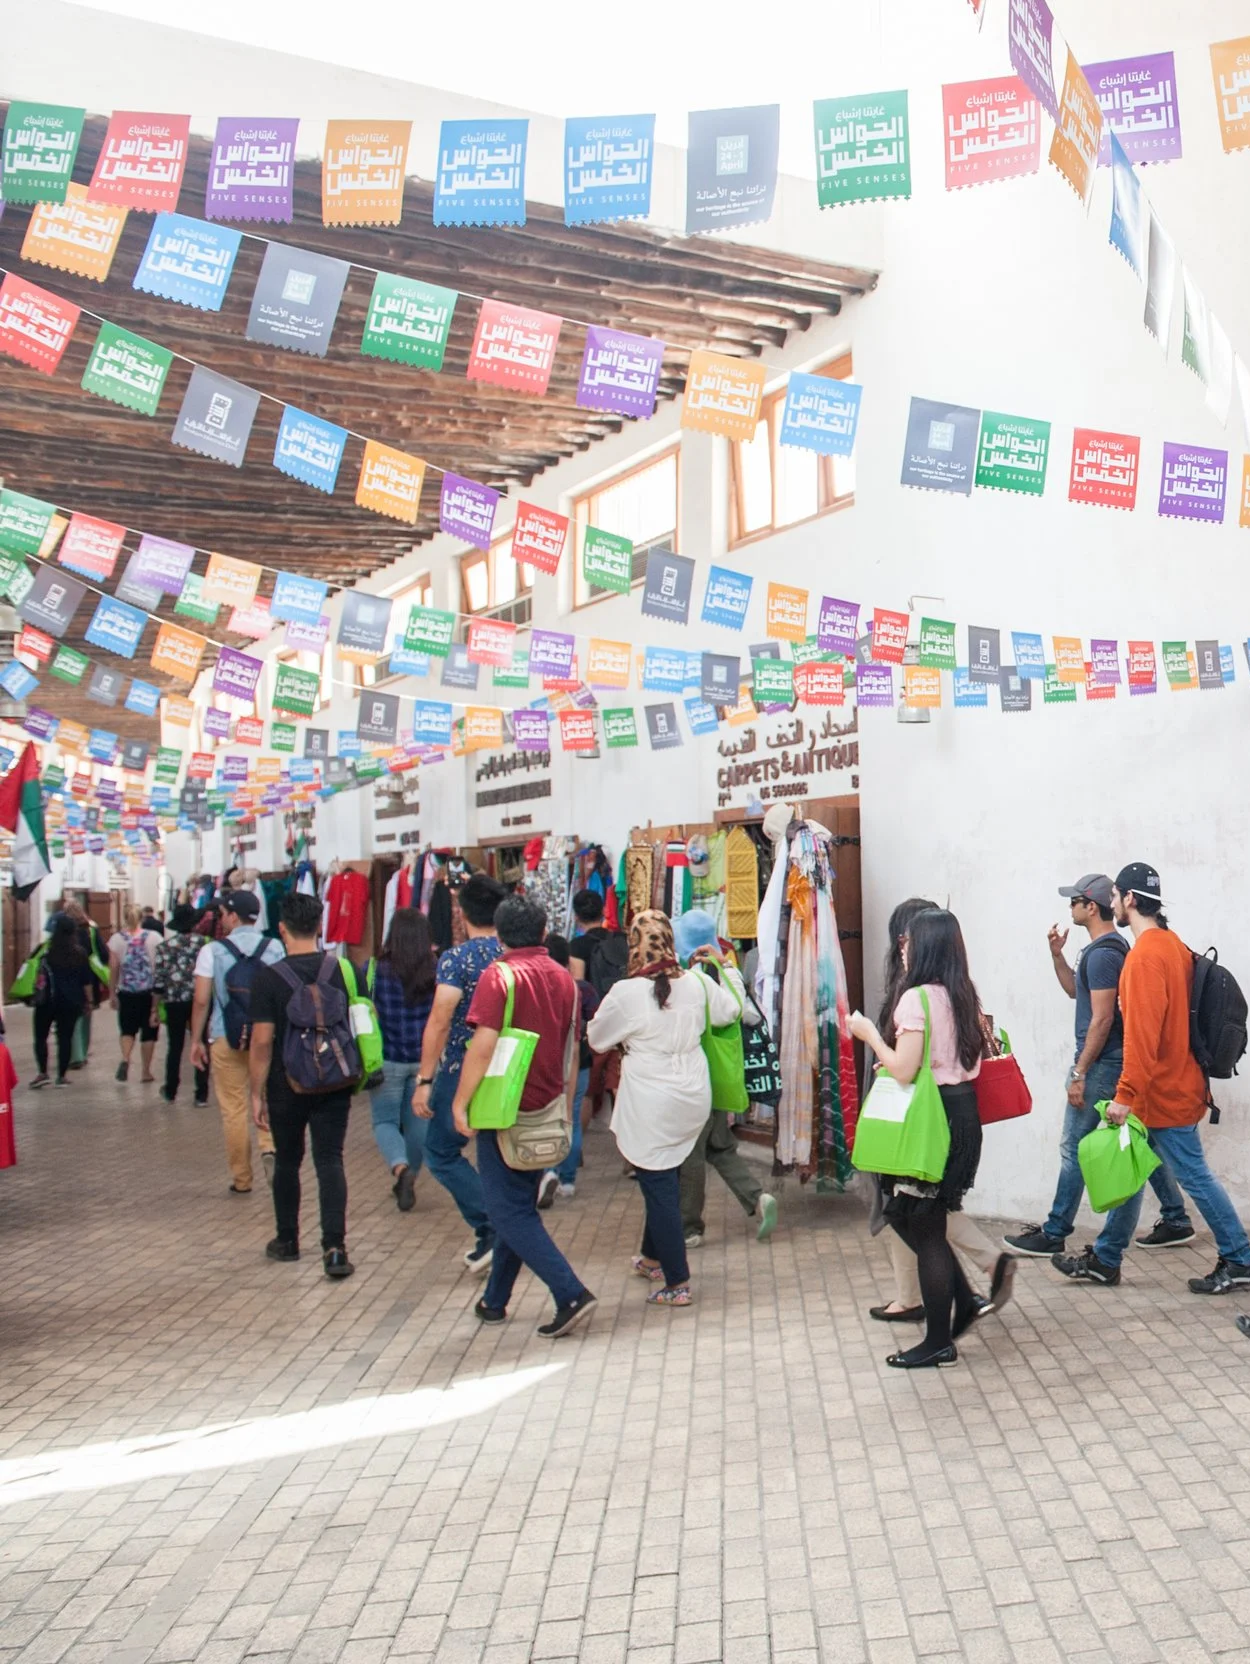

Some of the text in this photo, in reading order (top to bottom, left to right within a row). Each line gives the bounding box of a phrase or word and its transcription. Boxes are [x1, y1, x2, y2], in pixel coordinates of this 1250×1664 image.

[949, 100, 1035, 137] الحواس
[6, 127, 75, 152] الحواس
[818, 116, 903, 151] الحواس
[950, 123, 1035, 162] الخمس
[106, 137, 183, 161] الحواس
[216, 142, 291, 166] الحواس
[442, 144, 521, 170] الحواس
[569, 139, 648, 168] الحواس
[819, 141, 904, 178] الخمس
[4, 152, 70, 173] الخمس
[99, 160, 180, 182] الخمس
[720, 159, 743, 171] April
[2, 175, 64, 189] FIVE SENSES
[213, 165, 288, 190] الخمس
[440, 167, 519, 195] الخمس
[569, 162, 647, 193] الخمس
[821, 173, 905, 190] FIVE SENSES
[96, 182, 174, 198] FIVE SENSES
[244, 195, 287, 203] SENSES
[474, 198, 519, 206] SENSES
[374, 295, 448, 324] الحواس
[369, 314, 444, 343] الخمس
[481, 323, 553, 351] الحواس
[367, 334, 438, 356] FIVE SENSES
[476, 340, 550, 369] الخمس
[587, 349, 658, 374] الحواس
[584, 367, 654, 393] الخمس
[582, 387, 649, 406] FIVE SENSES
[790, 393, 856, 417] الحواس
[786, 410, 853, 435] الخمس
[983, 432, 1045, 454] الحواس
[981, 450, 1044, 471] الخمس
[1075, 449, 1135, 469] الحواس
[979, 469, 1041, 484] FIVE SENSES
[1074, 465, 1134, 486] الخمس
[1166, 463, 1224, 482] الحواس
[1072, 484, 1132, 498] FIVE SENSES
[1164, 480, 1223, 499] الخمس
[444, 490, 493, 517] الحواس
[1163, 498, 1221, 511] FIVE SENSES
[443, 504, 491, 531] الخمس
[717, 757, 780, 788] CARPETS
[781, 751, 793, 772] &
